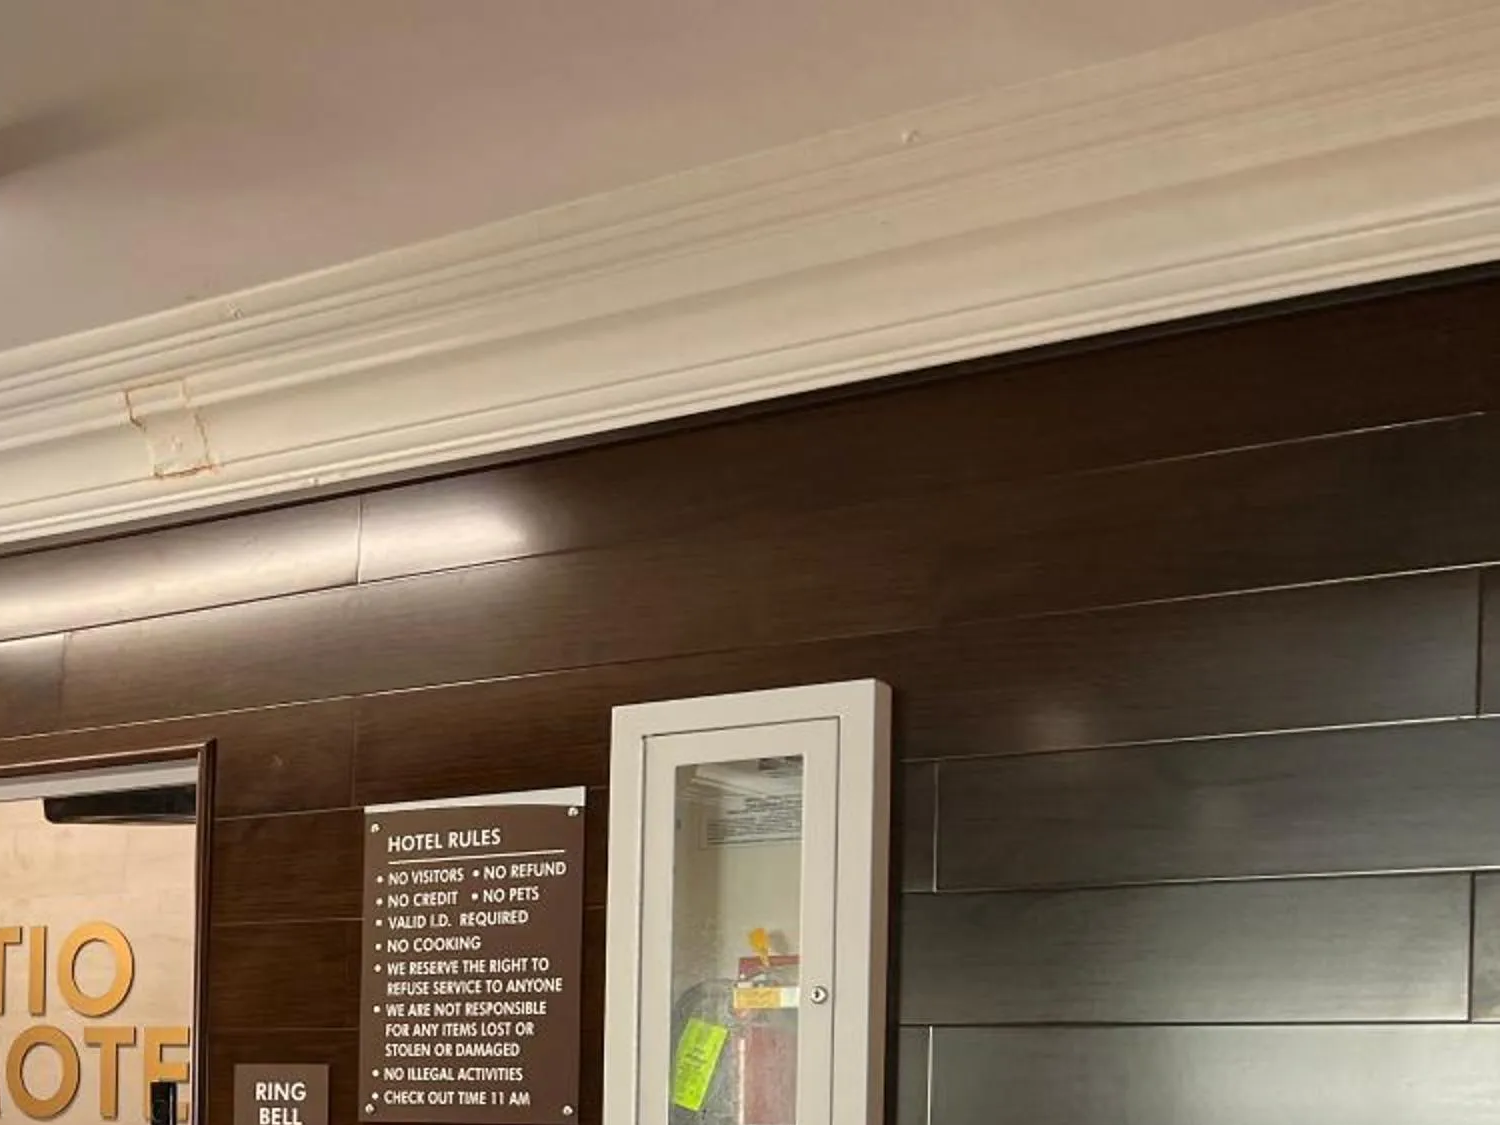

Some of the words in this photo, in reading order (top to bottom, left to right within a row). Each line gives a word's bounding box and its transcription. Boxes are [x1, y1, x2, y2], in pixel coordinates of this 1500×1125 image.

[388, 833, 442, 852] HOTEL
[448, 828, 501, 848] RULES
[387, 871, 408, 885] NO
[411, 867, 465, 884] VISITORS
[483, 865, 507, 880] NO
[511, 861, 567, 878] REFUND
[387, 894, 409, 908] NO
[413, 891, 459, 906] CREDIT
[483, 888, 505, 903] NO
[509, 886, 539, 901] PETS
[387, 914, 427, 929] VALID
[430, 914, 452, 928] I.D.
[459, 910, 529, 927] REQUIRED
[387, 939, 409, 953] NO
[413, 935, 482, 952] COOKING
[387, 962, 406, 975] WE
[409, 960, 459, 975] RESERVE
[462, 959, 487, 973] THE
[489, 957, 529, 973] RIGHT
[532, 957, 549, 972] TO
[387, 981, 430, 996] REFUSE
[433, 979, 483, 995] SERVICE
[486, 979, 502, 993] TO
[506, 977, 563, 993] ANYONE
[385, 1003, 405, 1017] WE
[407, 1003, 430, 1017] ARE
[433, 1003, 461, 1016] NOT
[465, 1001, 547, 1016] RESPONSIBLE
[385, 1023, 409, 1037] FOR
[412, 1023, 439, 1037] ANY
[442, 1022, 478, 1036] ITEMS
[481, 1021, 512, 1036] LOST
[515, 1021, 535, 1036] OR
[385, 1043, 431, 1057] STOLEN
[433, 1043, 453, 1057] OR
[455, 1043, 521, 1057] DAMAGED
[383, 1067, 404, 1081] NO
[407, 1067, 454, 1081] ILLEGAL
[457, 1067, 524, 1081] ACTIVITIES
[255, 1082, 306, 1101] RING
[383, 1091, 425, 1105] CHECK
[427, 1091, 455, 1105] OUT
[457, 1091, 487, 1105] TIME
[491, 1092, 505, 1105] 11
[509, 1092, 531, 1106] AM
